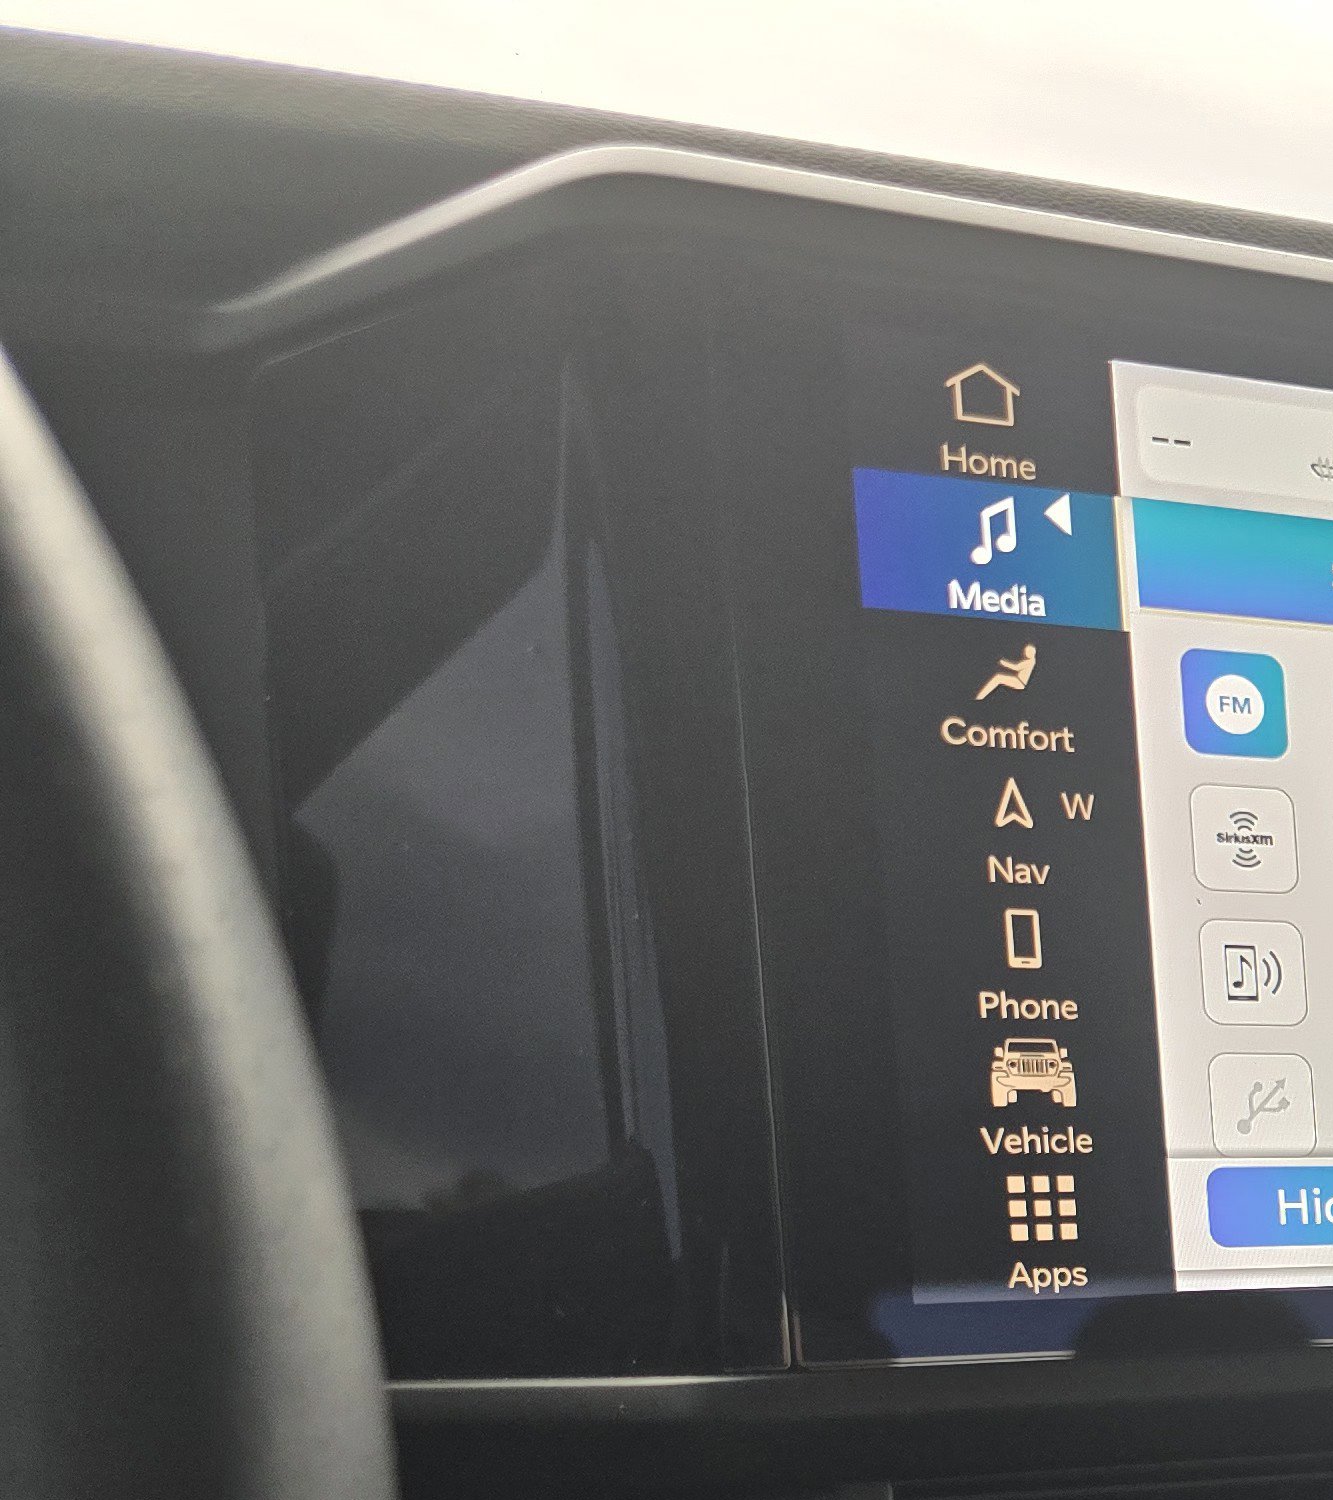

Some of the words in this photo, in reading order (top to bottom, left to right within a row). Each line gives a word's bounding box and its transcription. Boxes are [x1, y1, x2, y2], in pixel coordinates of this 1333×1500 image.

[940, 443, 1037, 481] Home
[947, 580, 1046, 617] Media
[1218, 695, 1252, 716] FM
[940, 717, 1075, 753] Comfort
[1061, 792, 1095, 820] W
[987, 855, 1050, 885] Nav
[978, 990, 1079, 1022] Phone
[979, 1125, 1093, 1155] Vehicle
[1008, 1261, 1088, 1294] Apps
